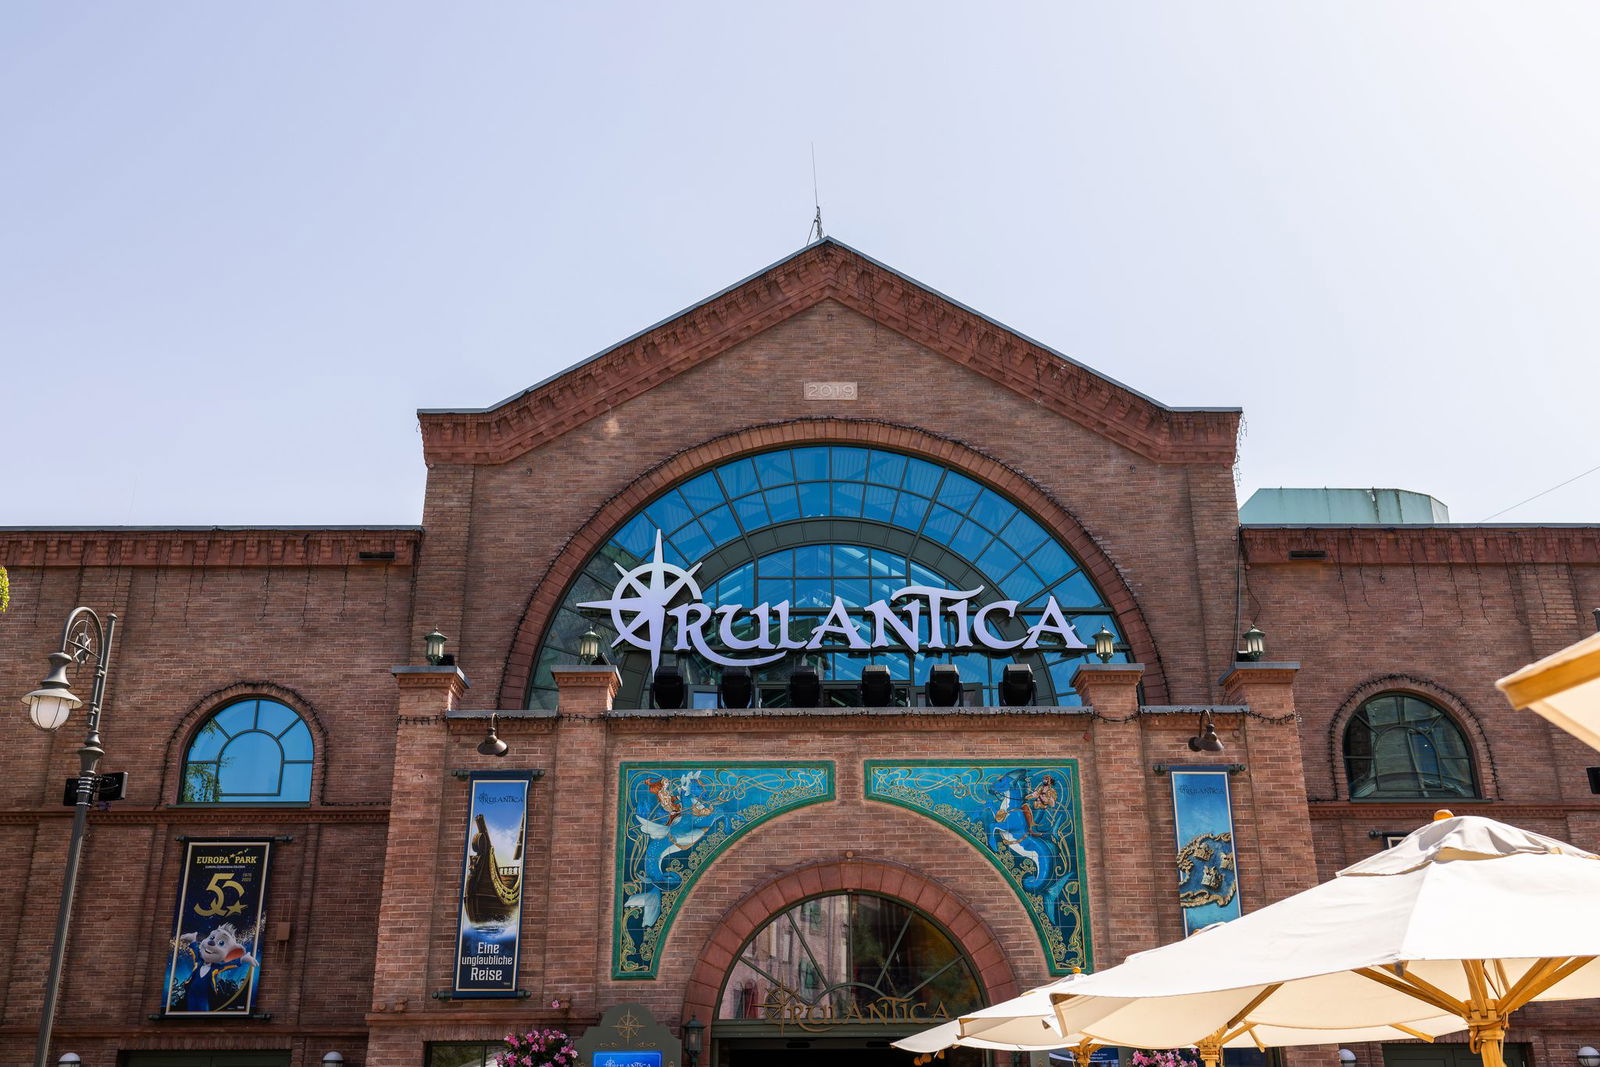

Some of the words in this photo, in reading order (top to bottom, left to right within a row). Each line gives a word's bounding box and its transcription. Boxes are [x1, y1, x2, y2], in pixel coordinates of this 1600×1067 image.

[808, 384, 855, 397] 2019
[667, 585, 1088, 667] RULANTICA
[196, 856, 229, 864] EUROPA
[234, 856, 257, 864] PARK
[477, 941, 500, 954] Eine
[461, 955, 513, 966] unglaubliche
[470, 967, 503, 981] Reise
[787, 996, 954, 1032] RULANTICA
